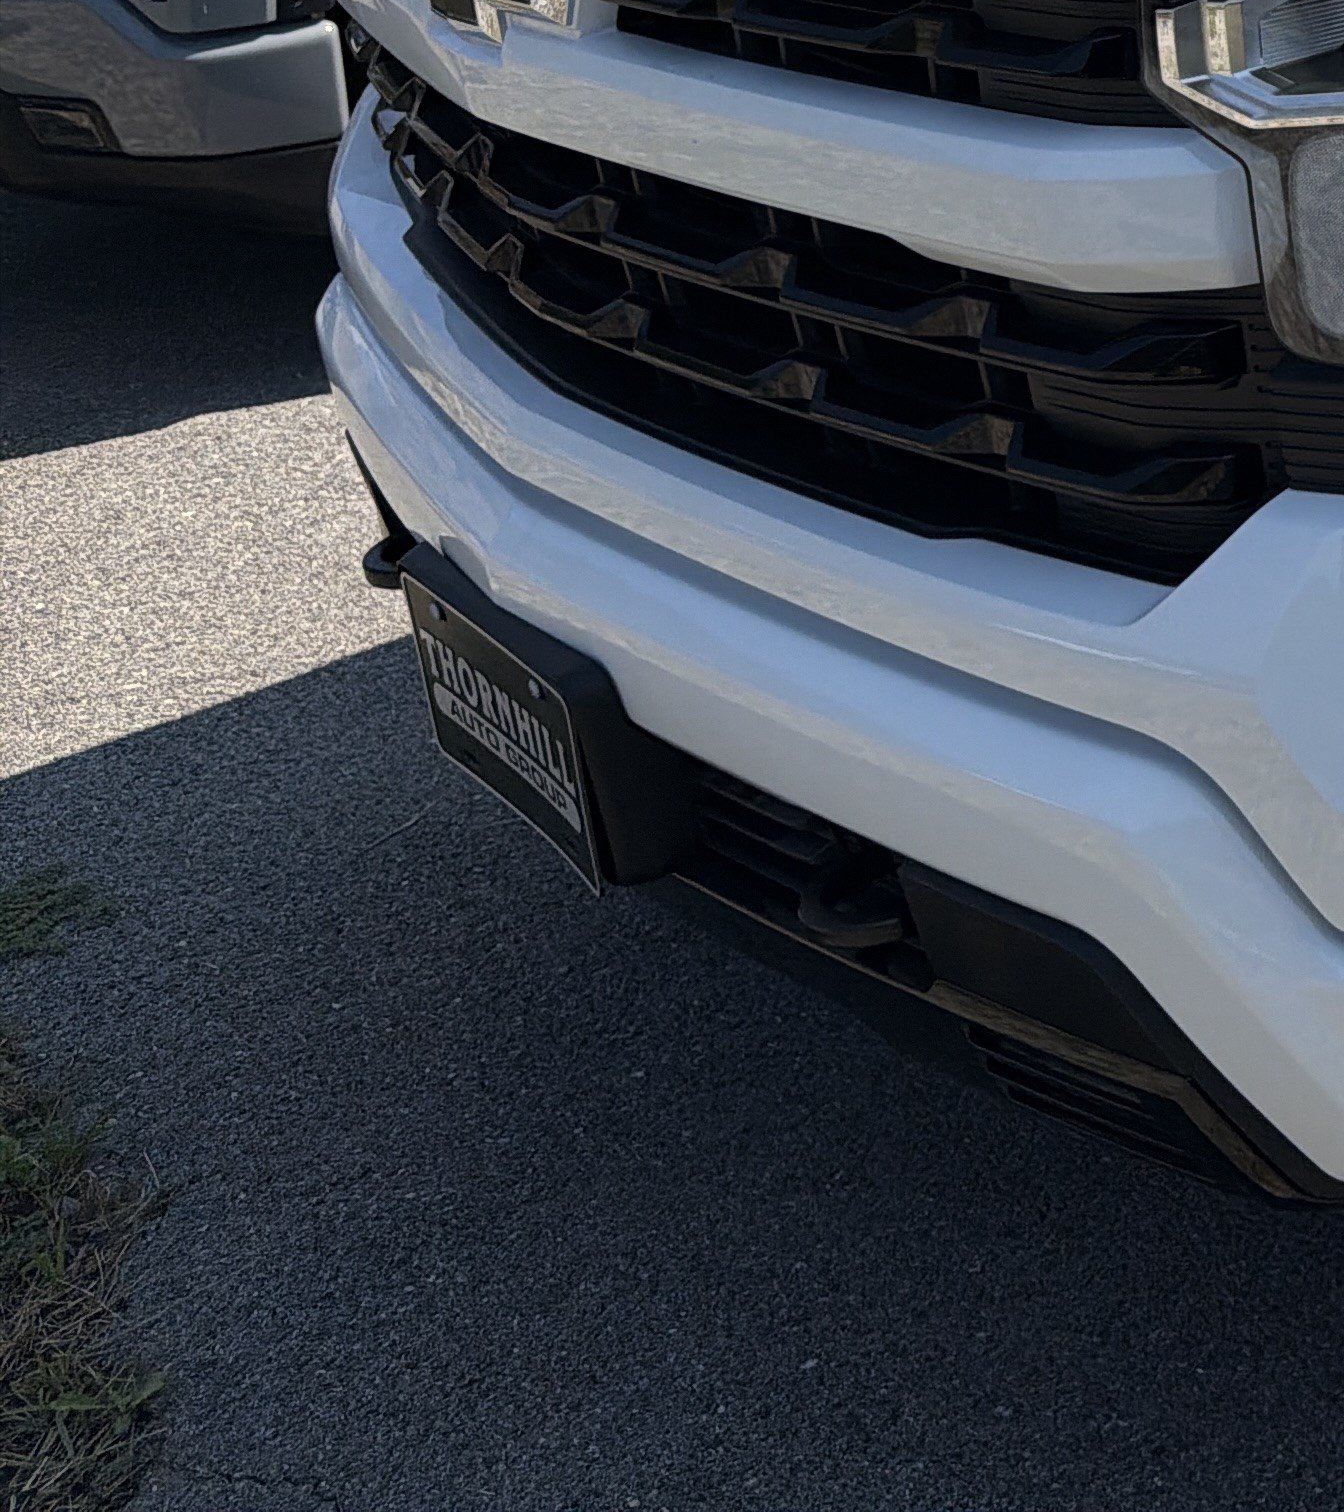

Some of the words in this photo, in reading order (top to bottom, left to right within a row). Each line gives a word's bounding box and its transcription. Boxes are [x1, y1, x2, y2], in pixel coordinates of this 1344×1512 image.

[418, 626, 577, 800] THORNHILL
[451, 701, 499, 750] AUTO
[506, 746, 568, 809] GROUP
